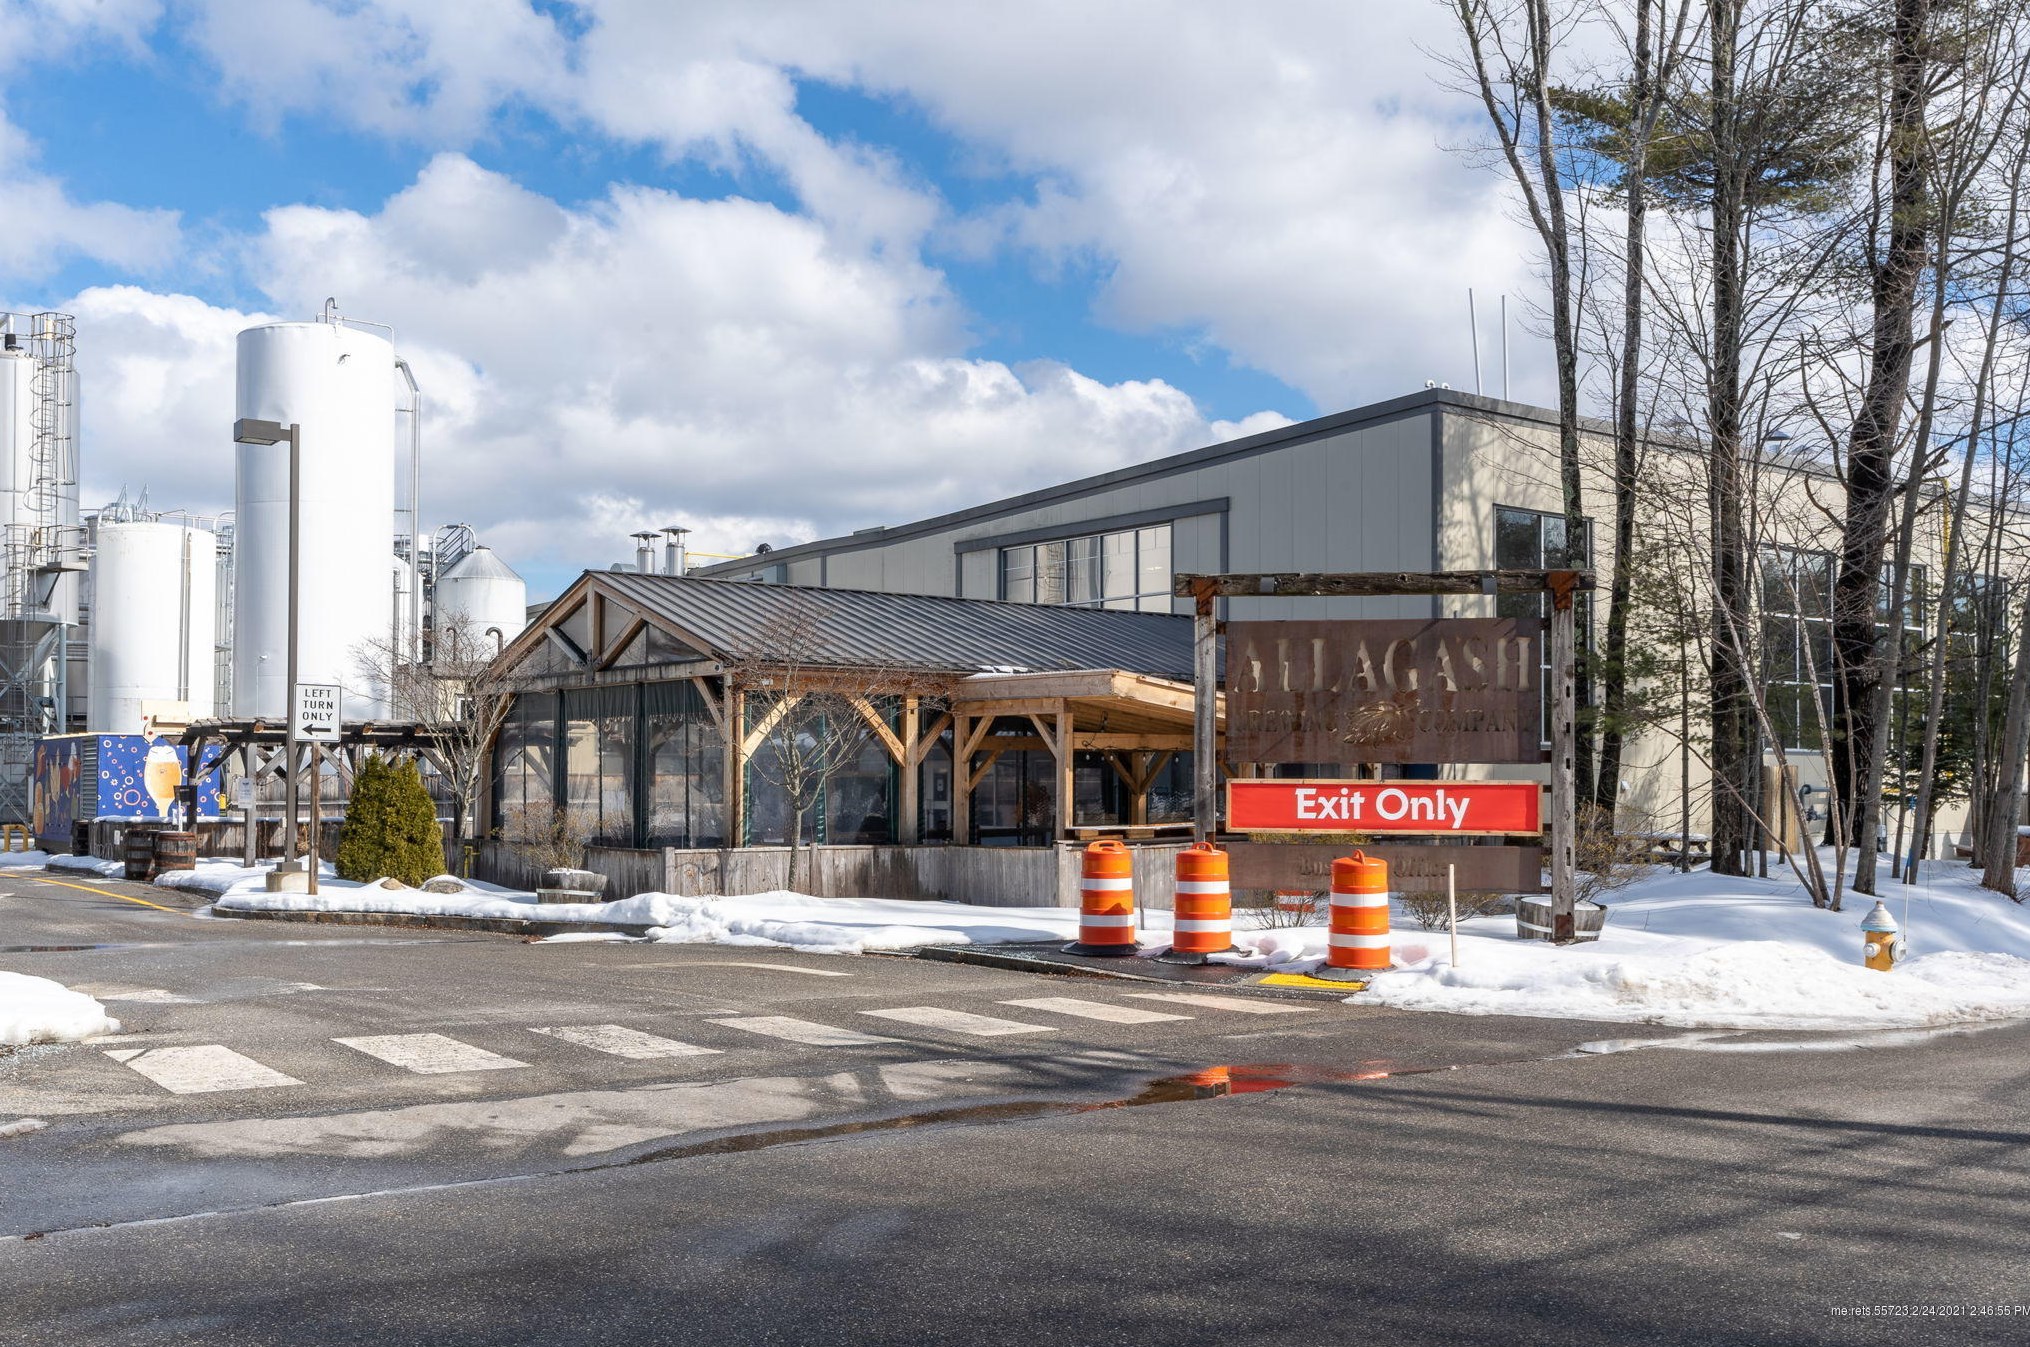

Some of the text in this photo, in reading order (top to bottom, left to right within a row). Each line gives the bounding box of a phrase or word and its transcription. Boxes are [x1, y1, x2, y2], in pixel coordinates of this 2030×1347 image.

[1234, 637, 1534, 692] ALLAGASH
[305, 688, 332, 698] LEFT
[303, 699, 333, 710] TURN
[302, 711, 333, 721] ONLY
[1295, 787, 1470, 829] Exit Only
